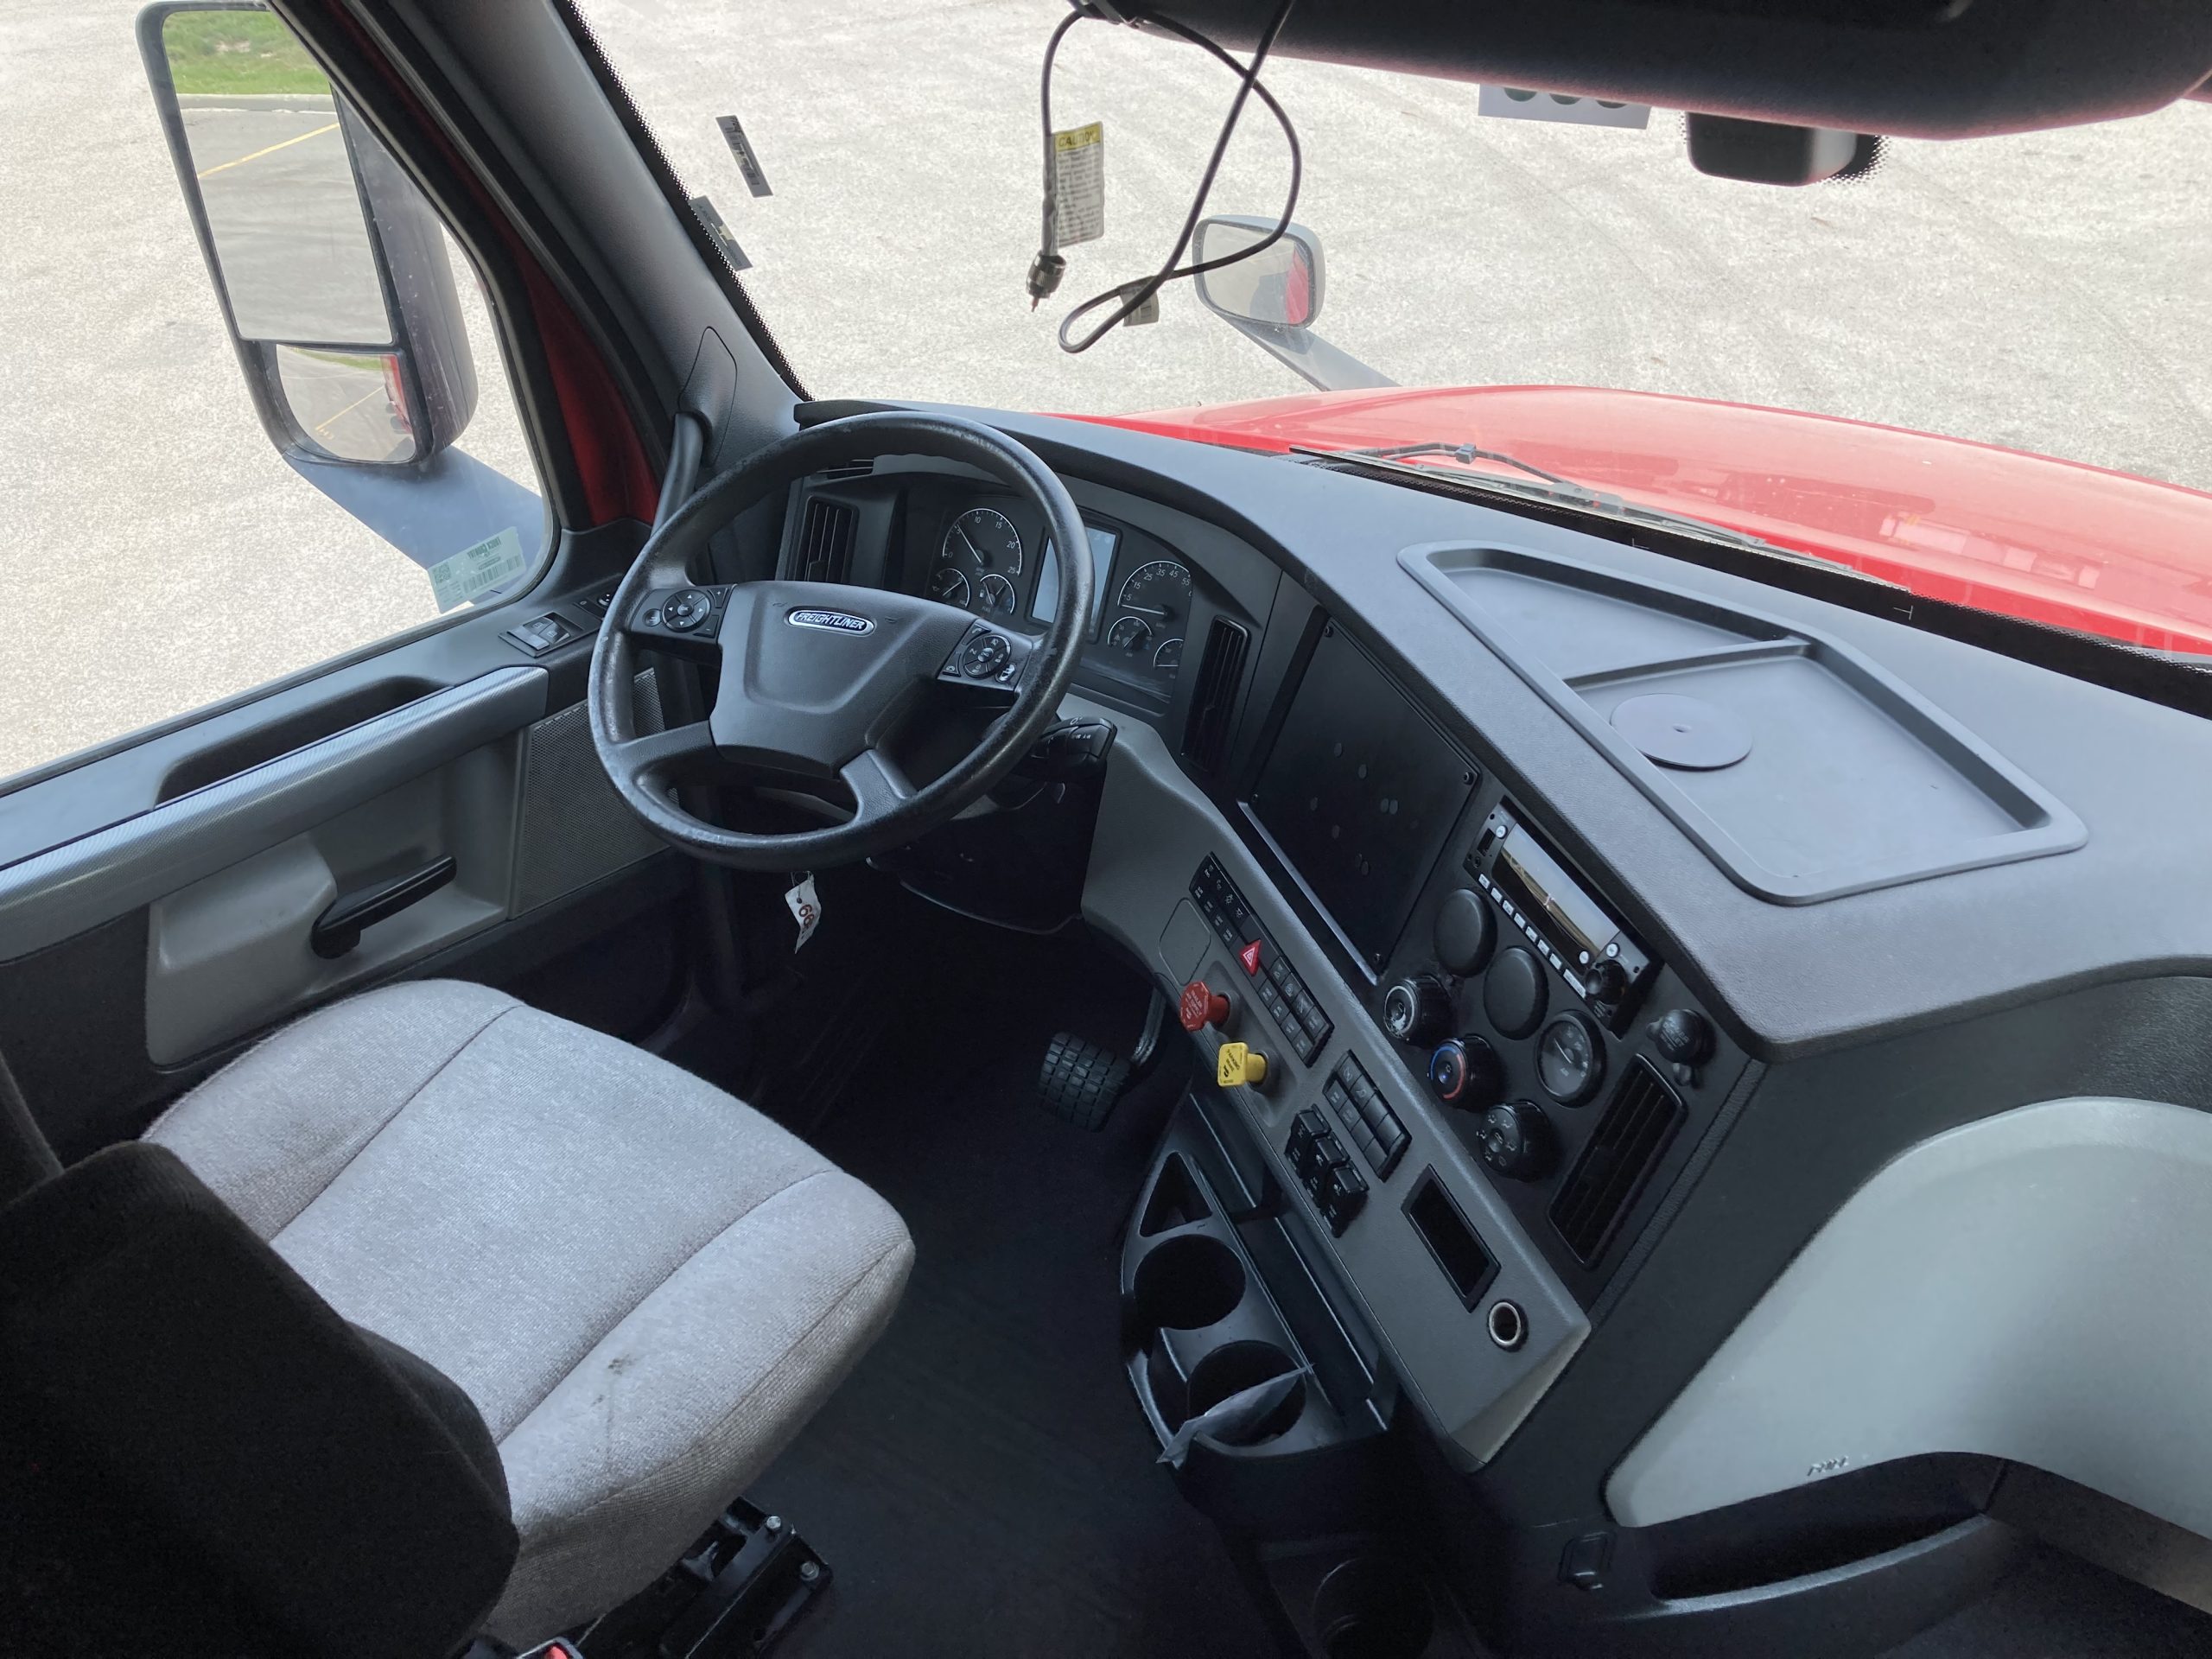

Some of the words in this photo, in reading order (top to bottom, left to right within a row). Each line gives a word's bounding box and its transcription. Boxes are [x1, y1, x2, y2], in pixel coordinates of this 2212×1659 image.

[1007, 540, 1016, 549] 20
[1007, 566, 1016, 575] 25
[1156, 568, 1166, 577] 35
[1168, 569, 1179, 578] 45
[1143, 572, 1154, 582] 25
[1181, 577, 1191, 586] 55
[796, 612, 865, 630] FREIGHTLINER
